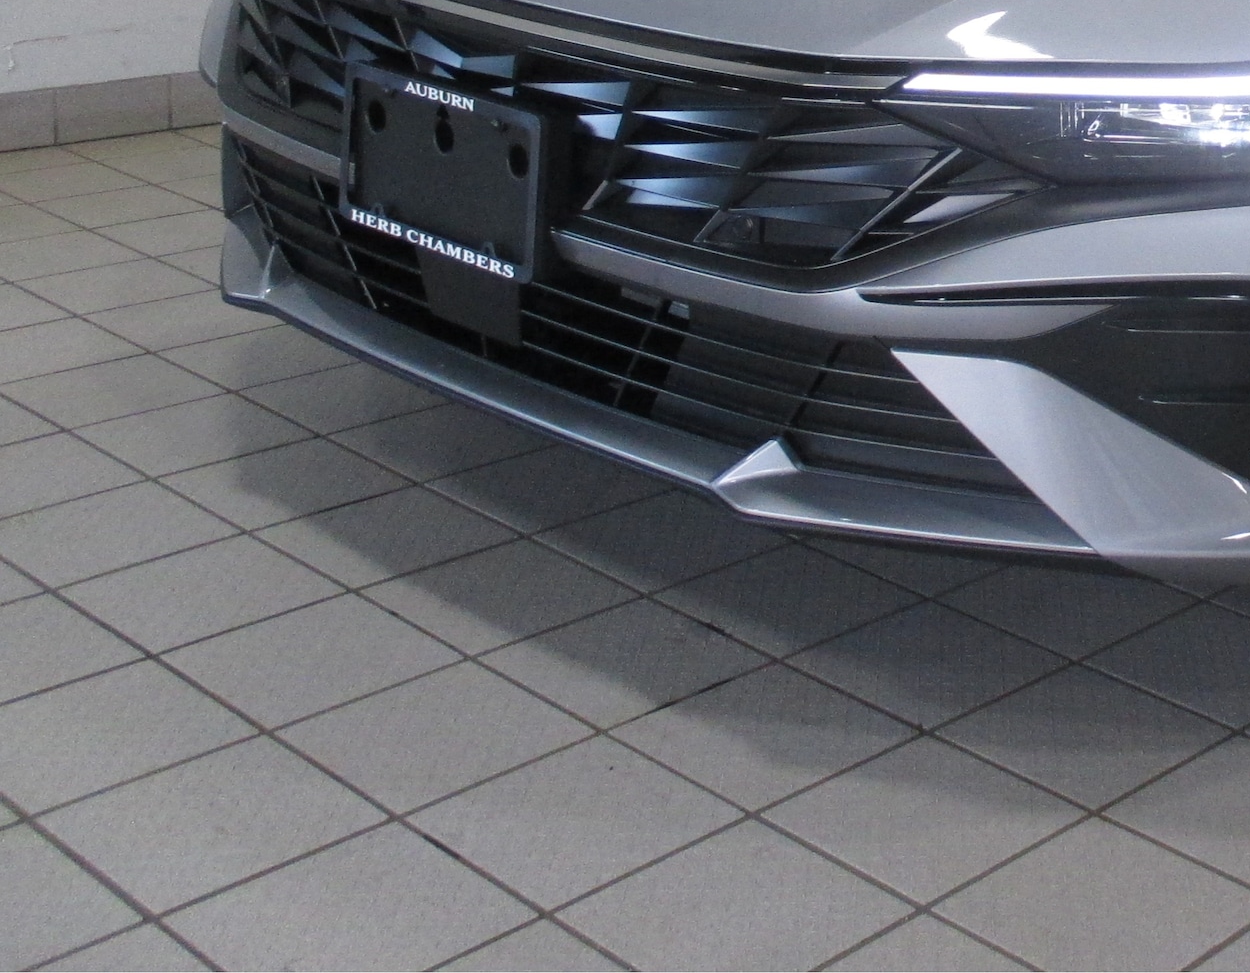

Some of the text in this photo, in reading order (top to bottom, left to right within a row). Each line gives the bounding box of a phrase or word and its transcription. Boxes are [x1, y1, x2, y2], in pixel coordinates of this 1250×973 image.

[404, 81, 475, 112] AUBURN
[351, 209, 515, 279] HERB CHAMBERS
